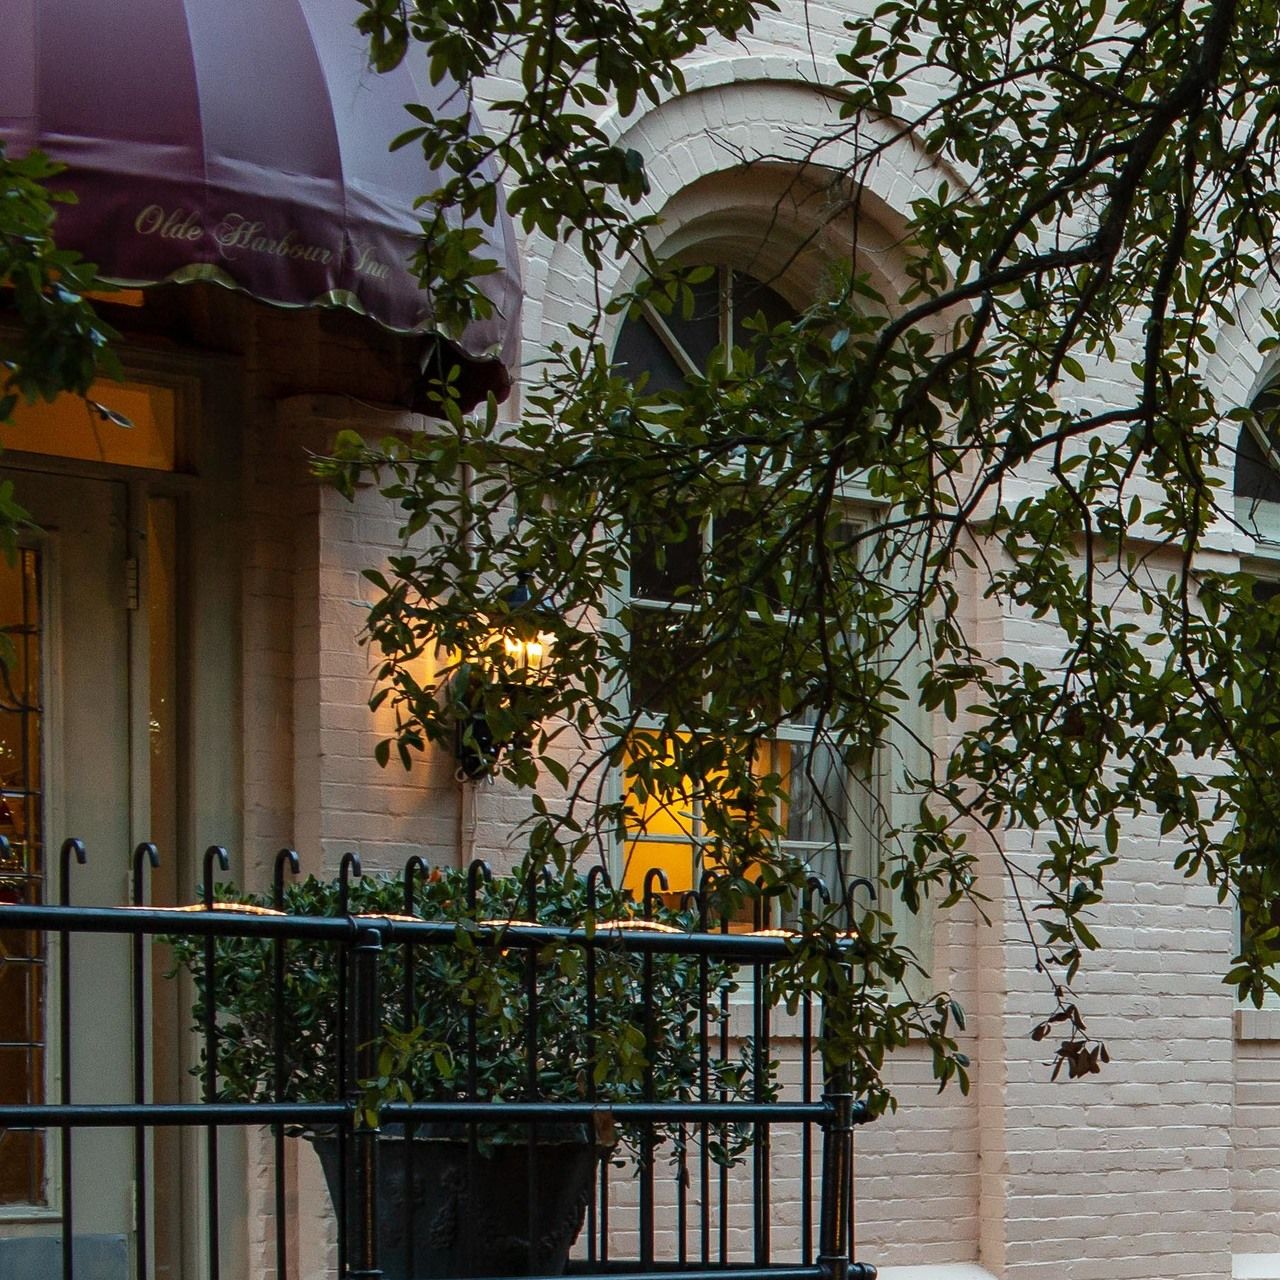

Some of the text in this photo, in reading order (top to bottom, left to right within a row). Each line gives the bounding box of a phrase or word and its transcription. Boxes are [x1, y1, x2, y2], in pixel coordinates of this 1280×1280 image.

[134, 203, 390, 280] Olde Harbour Inn
